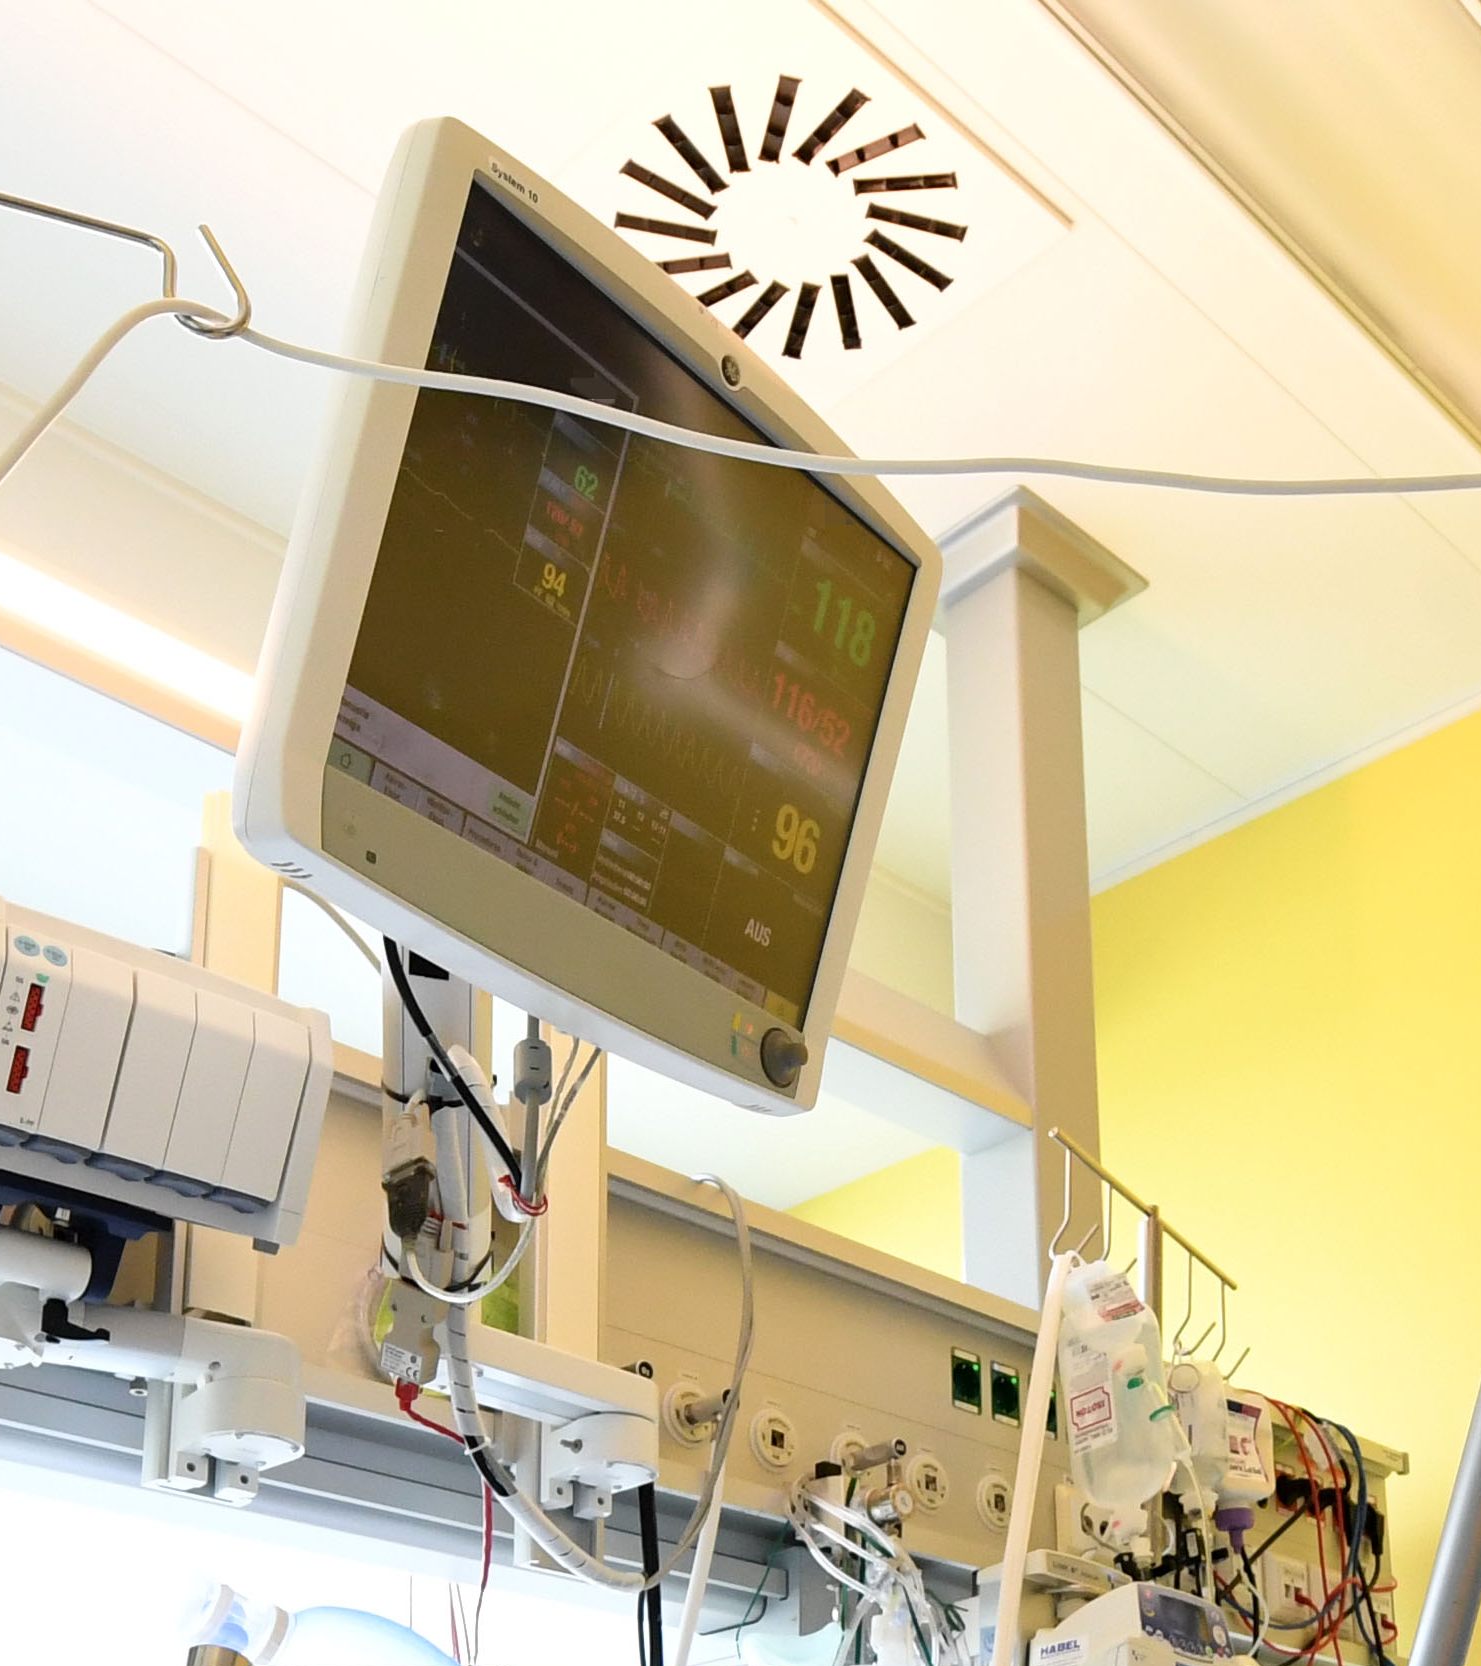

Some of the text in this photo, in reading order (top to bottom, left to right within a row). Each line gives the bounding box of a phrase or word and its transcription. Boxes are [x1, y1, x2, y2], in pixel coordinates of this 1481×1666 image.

[491, 162, 539, 204] System 10
[574, 464, 599, 501] 62
[541, 562, 568, 598] 94
[813, 578, 877, 669] 118
[771, 803, 821, 875] 96
[744, 917, 772, 947] AUS
[1040, 1639, 1081, 1656] HABEL
